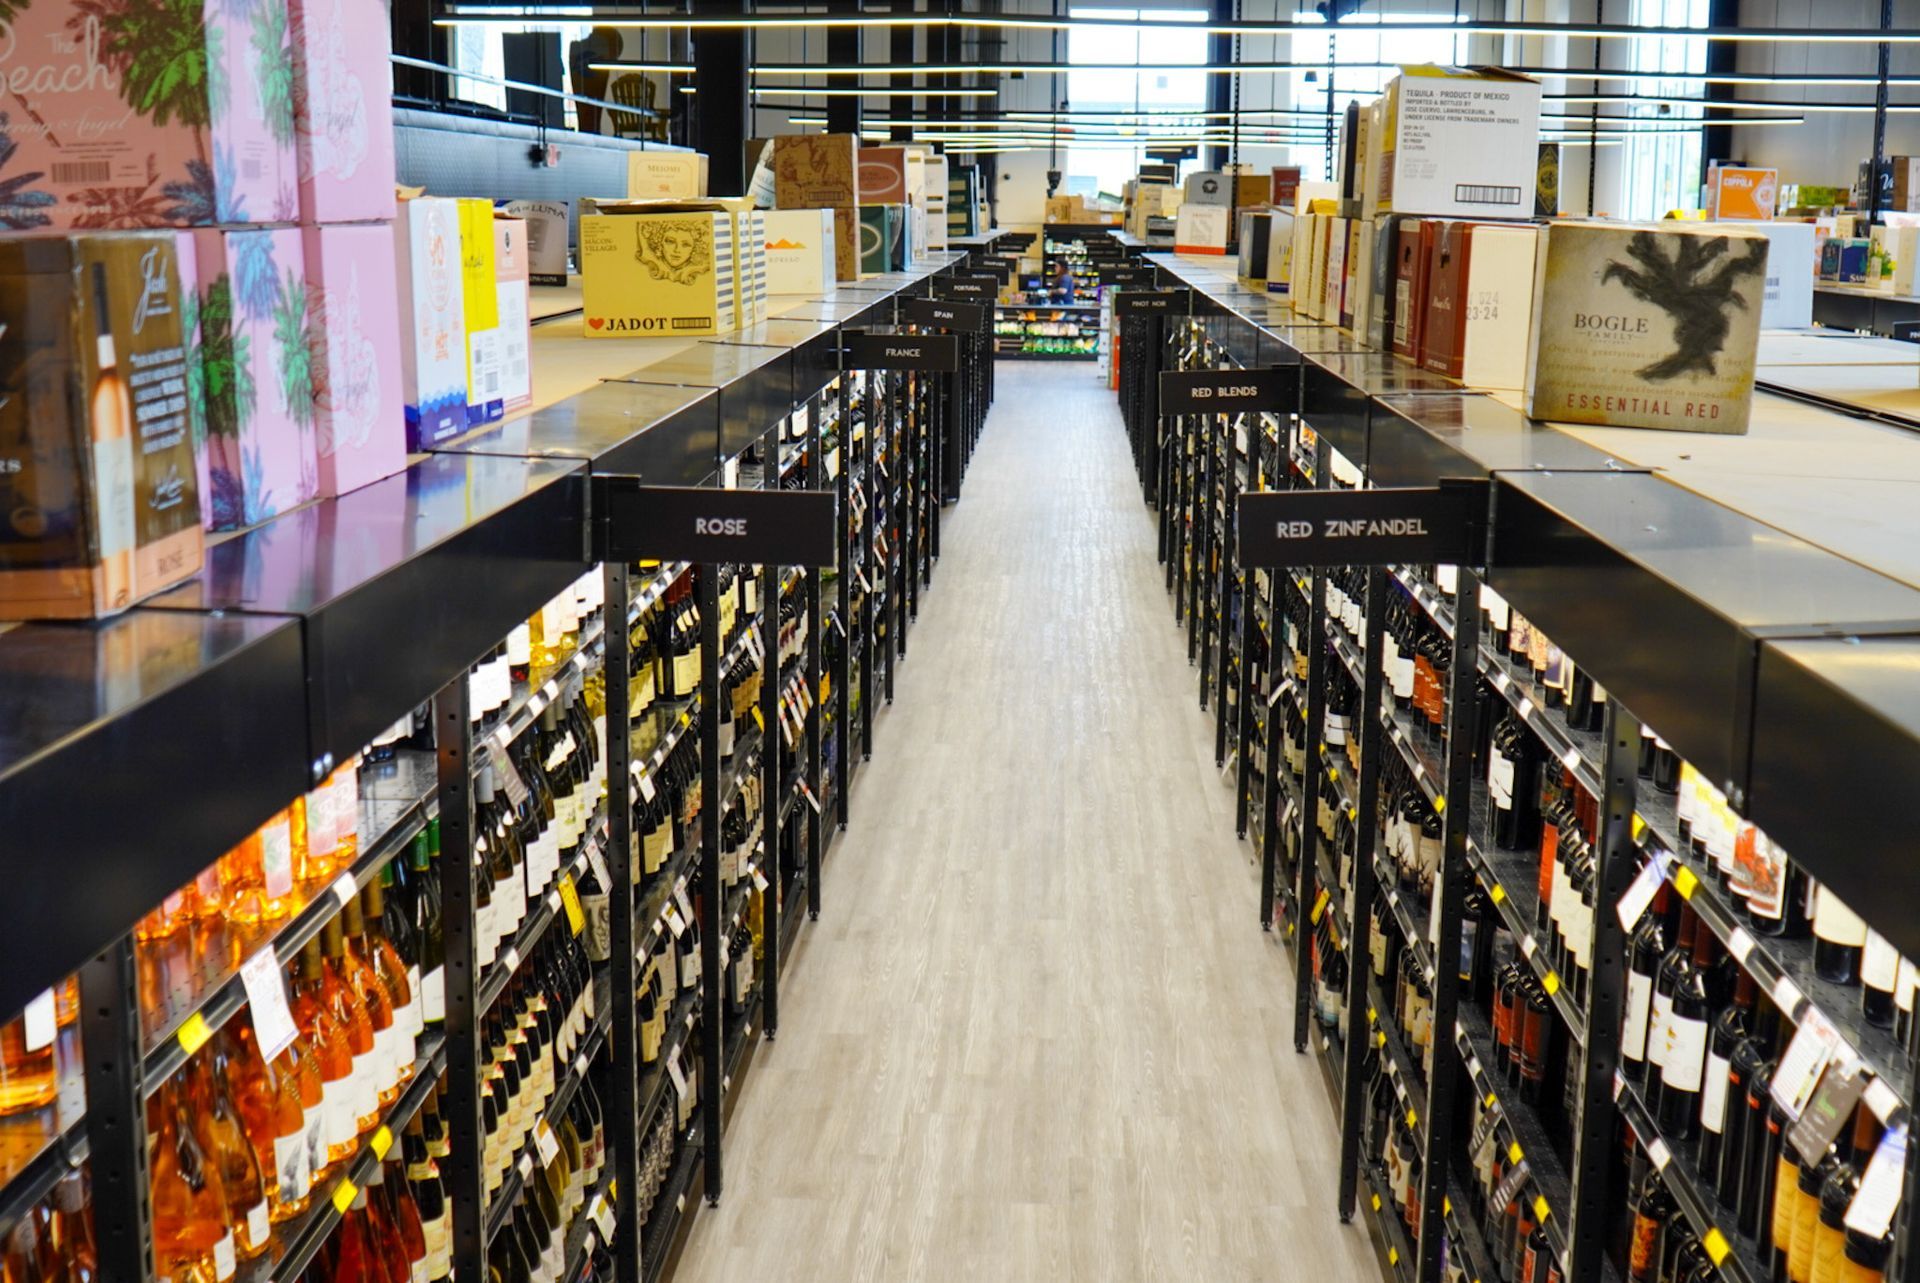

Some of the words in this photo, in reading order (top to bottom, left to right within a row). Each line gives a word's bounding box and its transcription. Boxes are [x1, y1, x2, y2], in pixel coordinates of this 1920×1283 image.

[1406, 89, 1434, 97] TEQUILA
[1440, 90, 1471, 98] PRODUCT
[1484, 93, 1510, 101] MEXICO
[1723, 177, 1753, 187] COPPOLA
[531, 204, 566, 220] LUNA
[933, 310, 954, 319] SPAIN
[606, 317, 667, 331] JADOT
[1574, 313, 1649, 334] BOGLE
[1587, 331, 1634, 341] FAMILY
[885, 348, 921, 357] FRANCE
[1191, 387, 1212, 398] RED
[1218, 386, 1258, 397] BLENDS
[1566, 393, 1671, 416] ESSENTIAL
[1684, 402, 1719, 419] RED
[695, 517, 748, 536] ROSE
[1276, 521, 1313, 538] RED
[1324, 518, 1428, 538] ZINFANDEL
